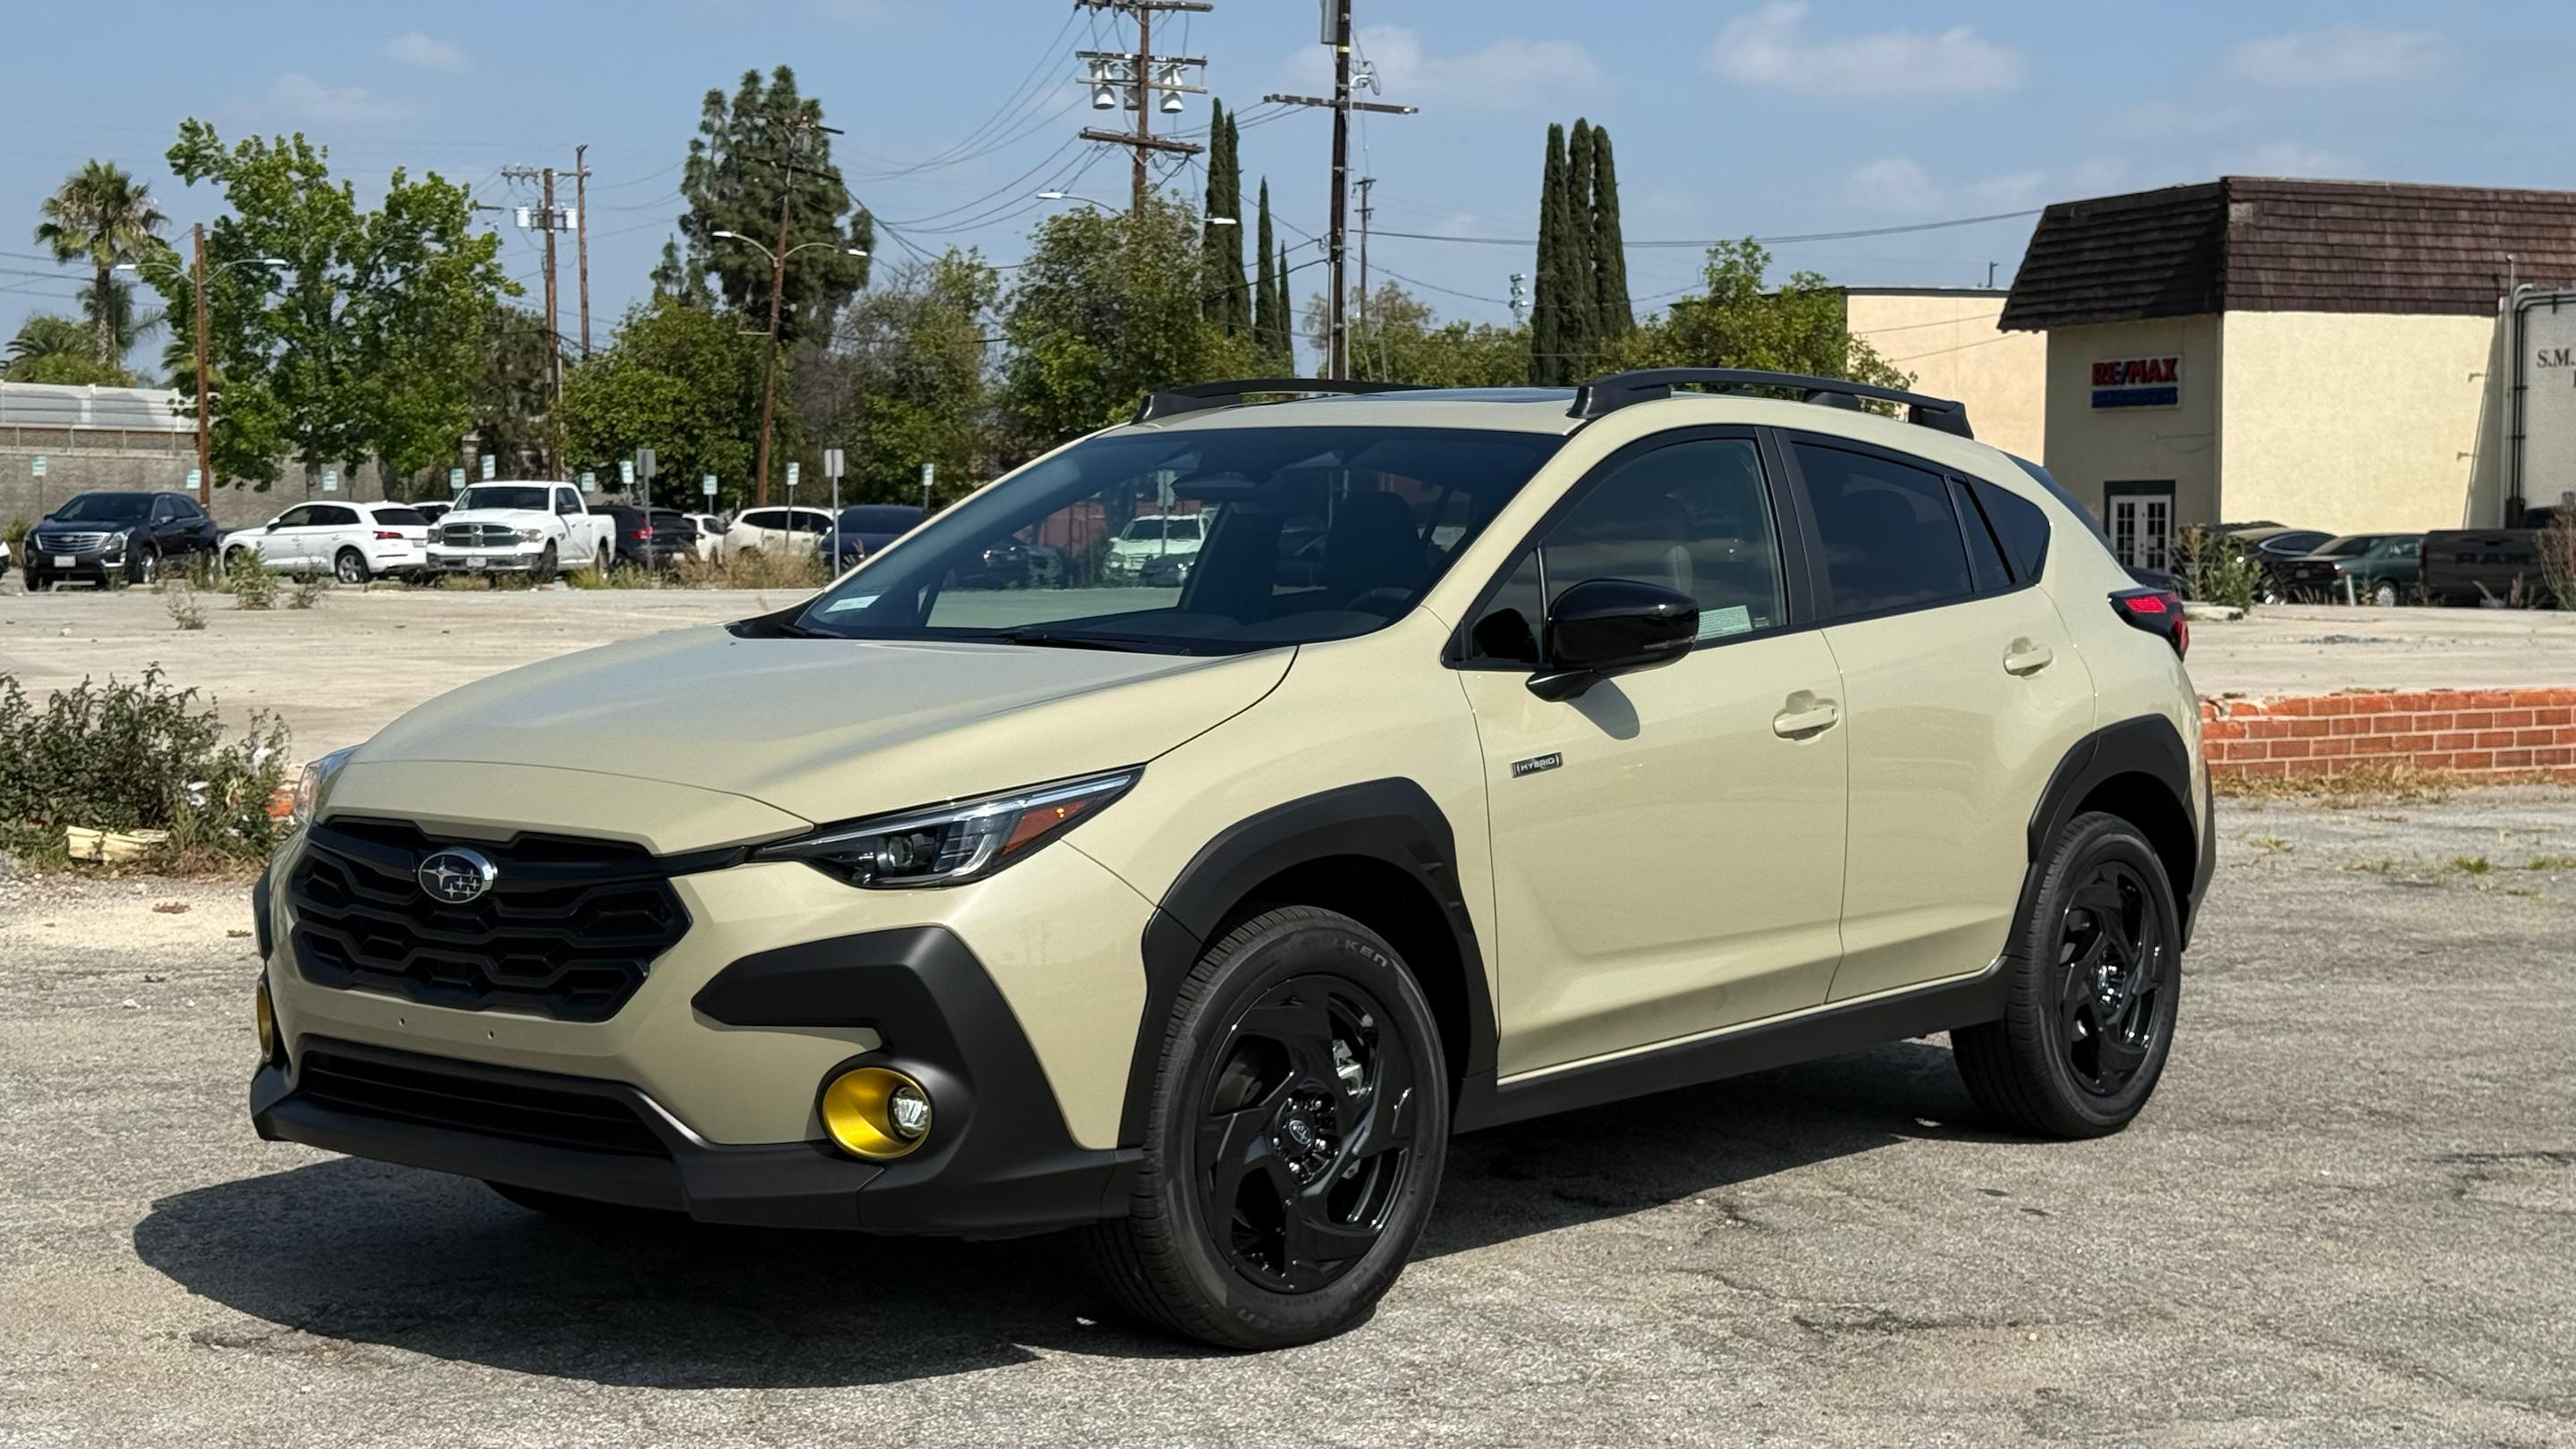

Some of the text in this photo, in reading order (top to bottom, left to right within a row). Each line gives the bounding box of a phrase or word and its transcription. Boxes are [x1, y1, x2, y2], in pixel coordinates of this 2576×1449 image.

[2092, 359, 2177, 385] RE/MAX
[2456, 552, 2529, 565] RAM
[1521, 758, 1555, 772] HYBRID
